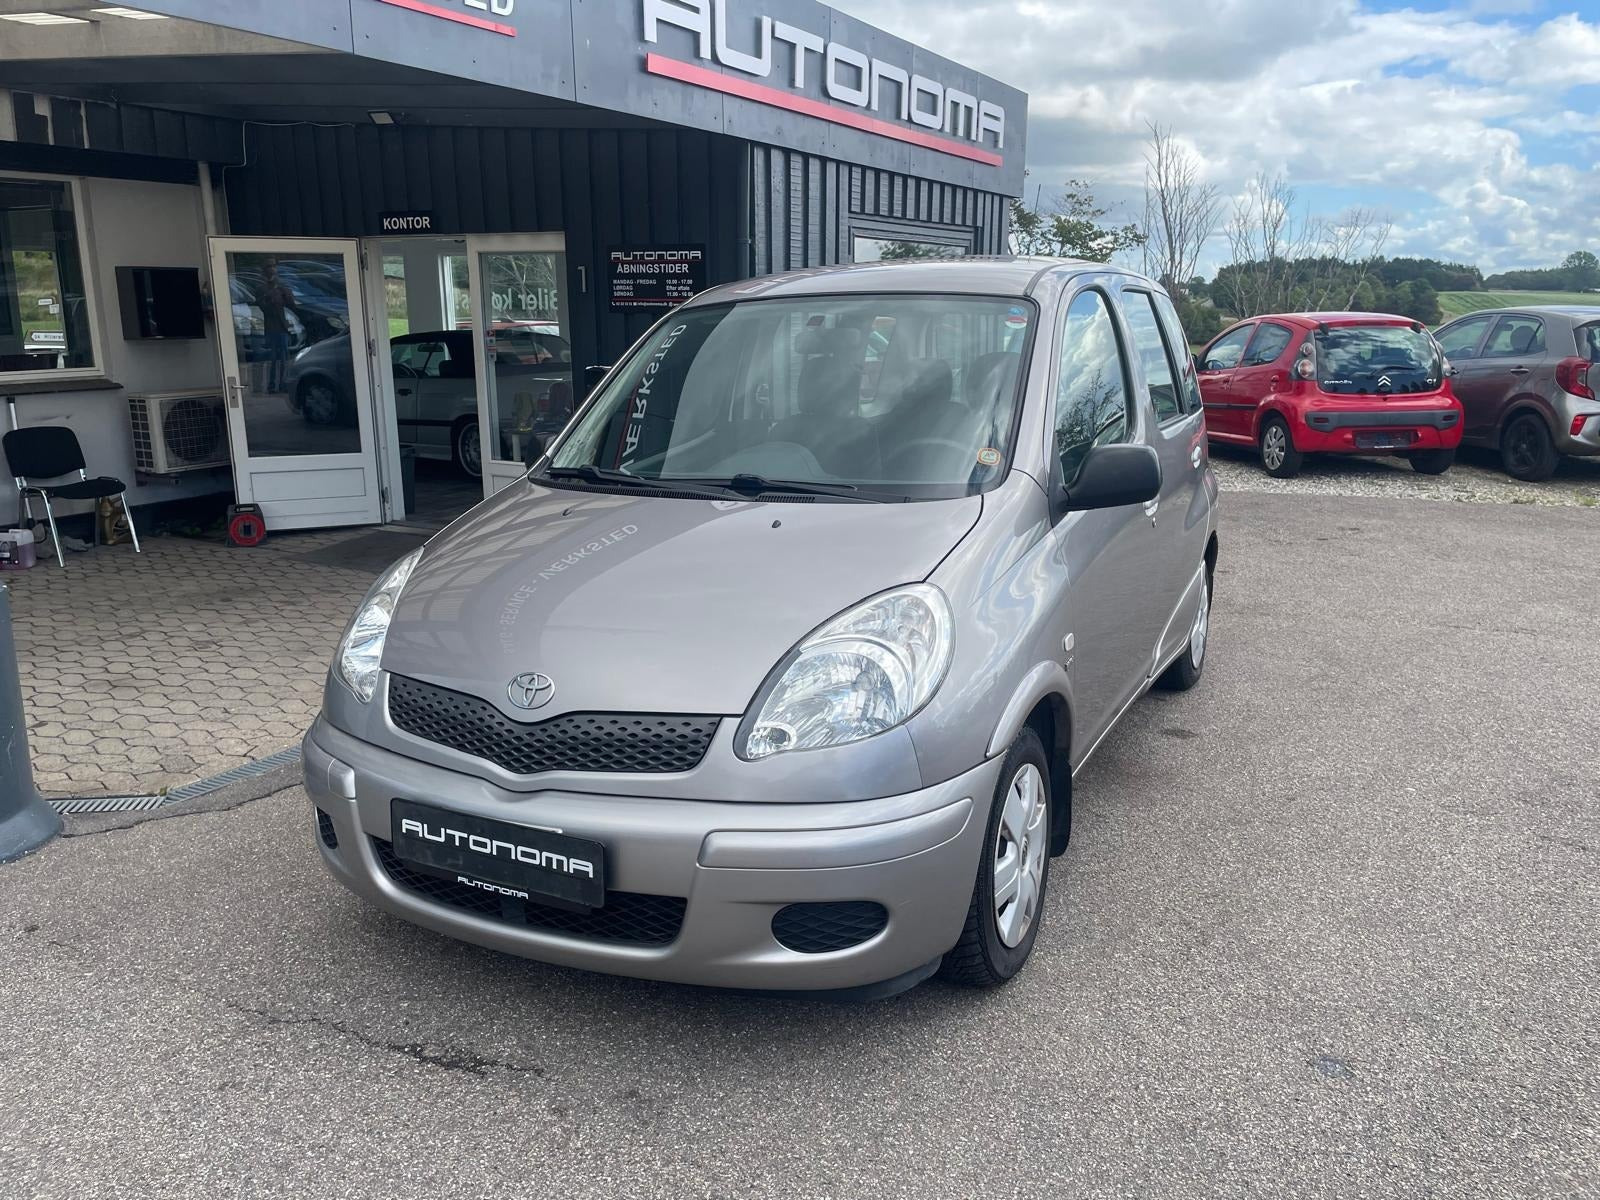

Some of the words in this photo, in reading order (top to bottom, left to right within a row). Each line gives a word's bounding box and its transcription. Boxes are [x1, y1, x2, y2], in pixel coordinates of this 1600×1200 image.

[643, 0, 1004, 149] AUTONOMA
[383, 216, 431, 230] KONTOR
[611, 250, 702, 260] AUTONOMA
[577, 265, 587, 293] 1
[616, 263, 689, 274] ÅBNINGSTIDER
[402, 818, 594, 878] AUTONOMA
[457, 876, 529, 900] AUTONOMA
